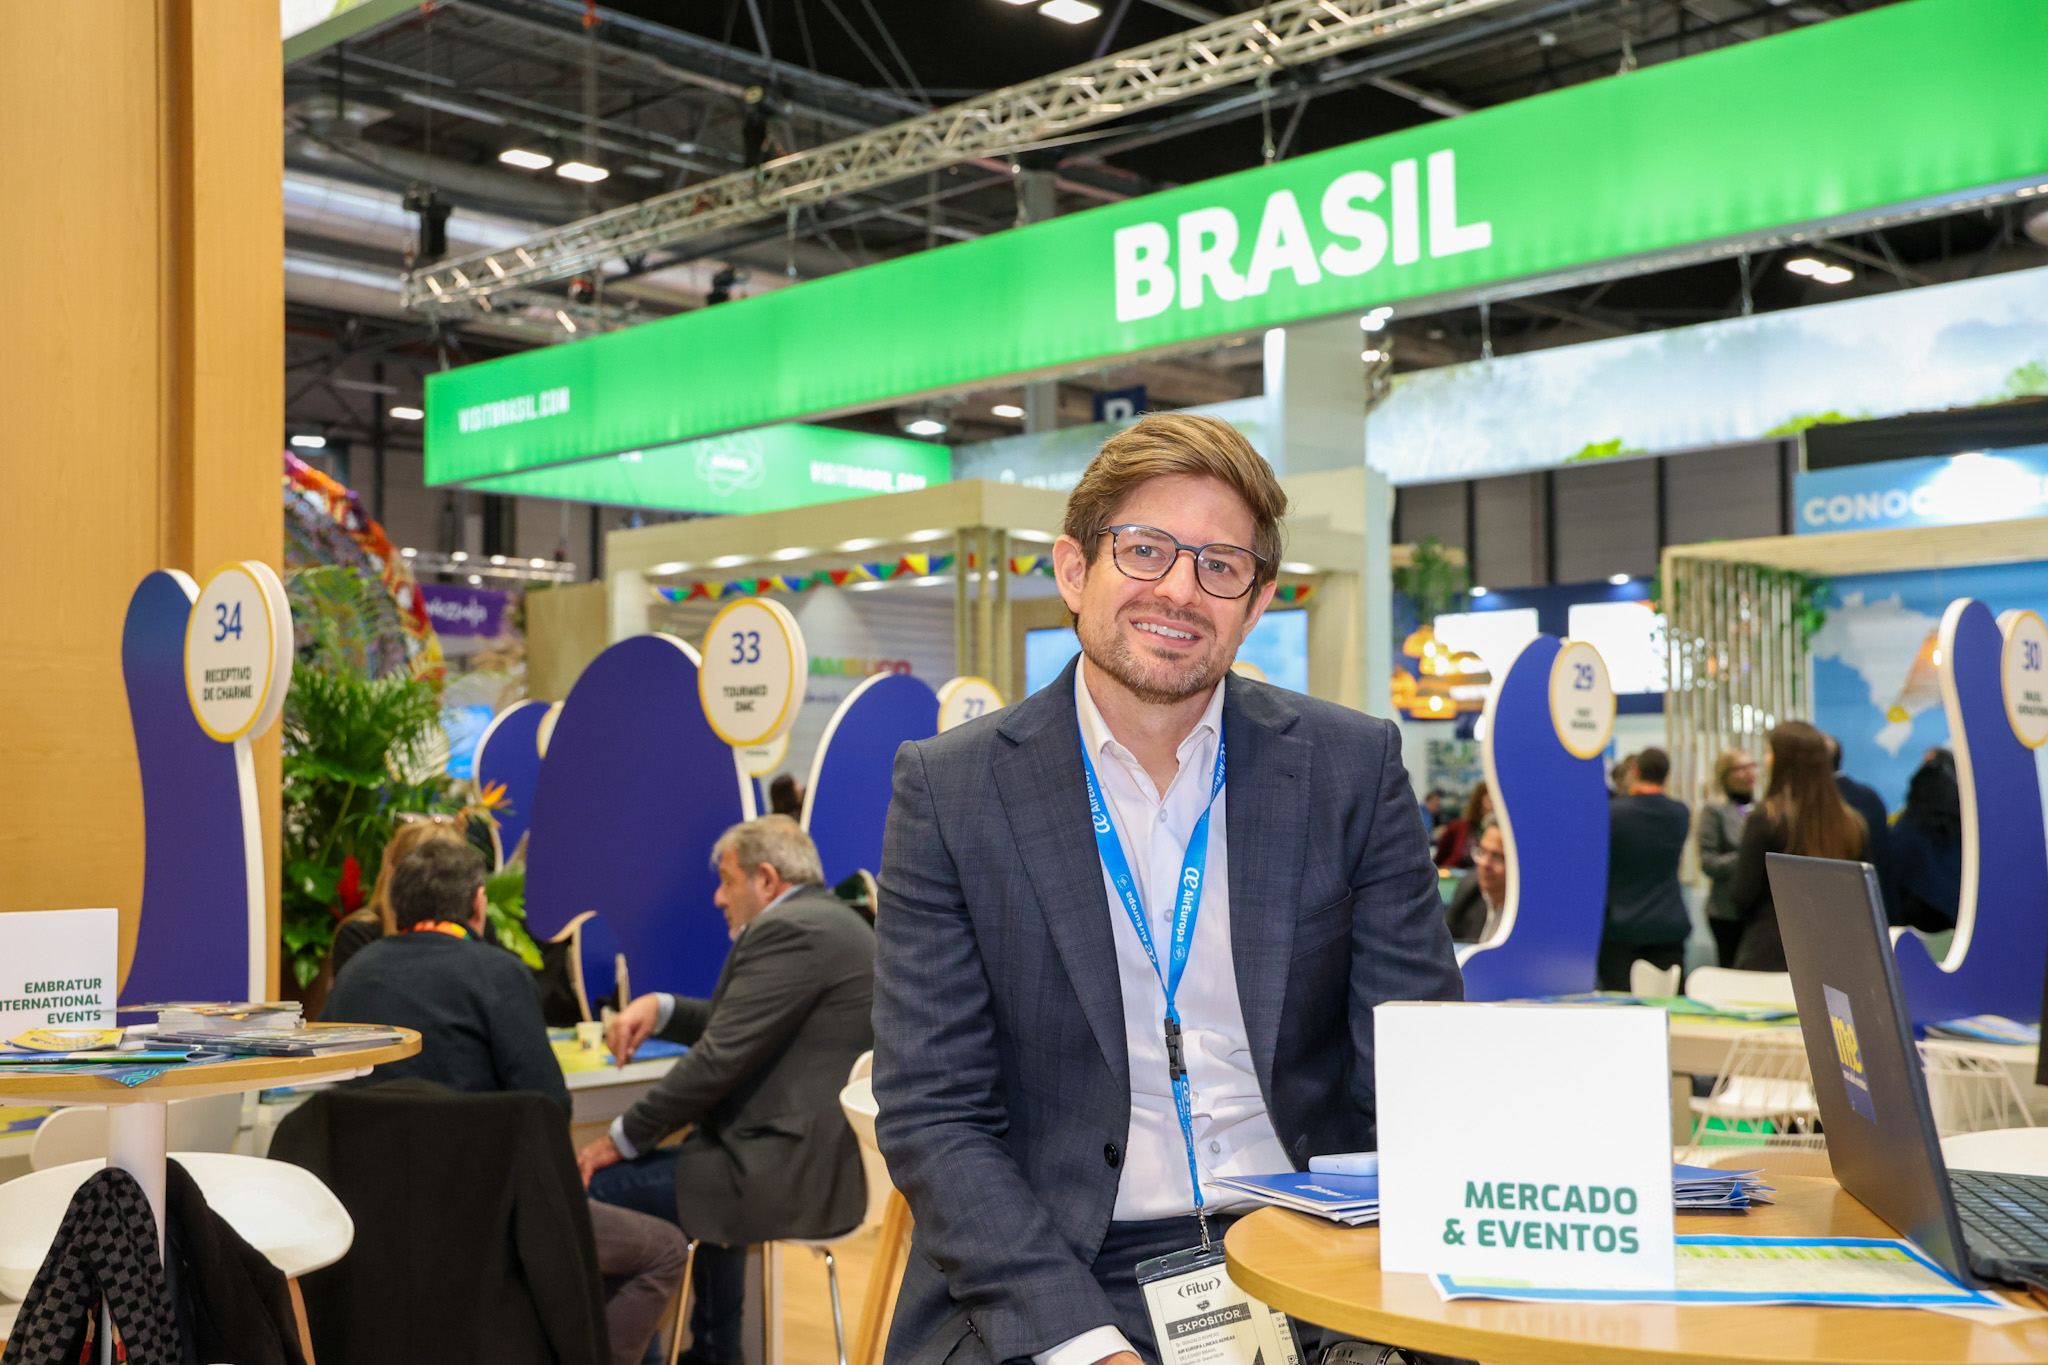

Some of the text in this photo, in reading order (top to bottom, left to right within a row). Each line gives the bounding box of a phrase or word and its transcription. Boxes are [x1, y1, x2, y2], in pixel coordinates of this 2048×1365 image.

[1114, 149, 1492, 322] BRASIL
[457, 385, 571, 435] VISITBRASIL.COM
[214, 601, 243, 643] 34
[730, 631, 761, 665] 33
[2022, 639, 2042, 672] 30
[205, 667, 252, 683] RECEPTIVO
[1573, 662, 1596, 691] 29
[204, 685, 253, 701] DE CHARME
[963, 699, 985, 720] 27
[1125, 890, 1149, 942] AirEuropa
[1176, 888, 1195, 943] AirEuropa
[24, 978, 102, 994] EMBRATUR
[0, 994, 102, 1012] TERNATIONAL
[47, 1009, 102, 1024] EVENTS
[1465, 1181, 1638, 1215] MERCADO
[1442, 1218, 1466, 1246] &
[1477, 1219, 1640, 1254] EVENTOS
[1176, 1309, 1241, 1334] EXPOSITOR
[1185, 1343, 1203, 1353] EUROPA
[1202, 1339, 1219, 1348] LINEAS
[1218, 1334, 1236, 1344] AEREAS
